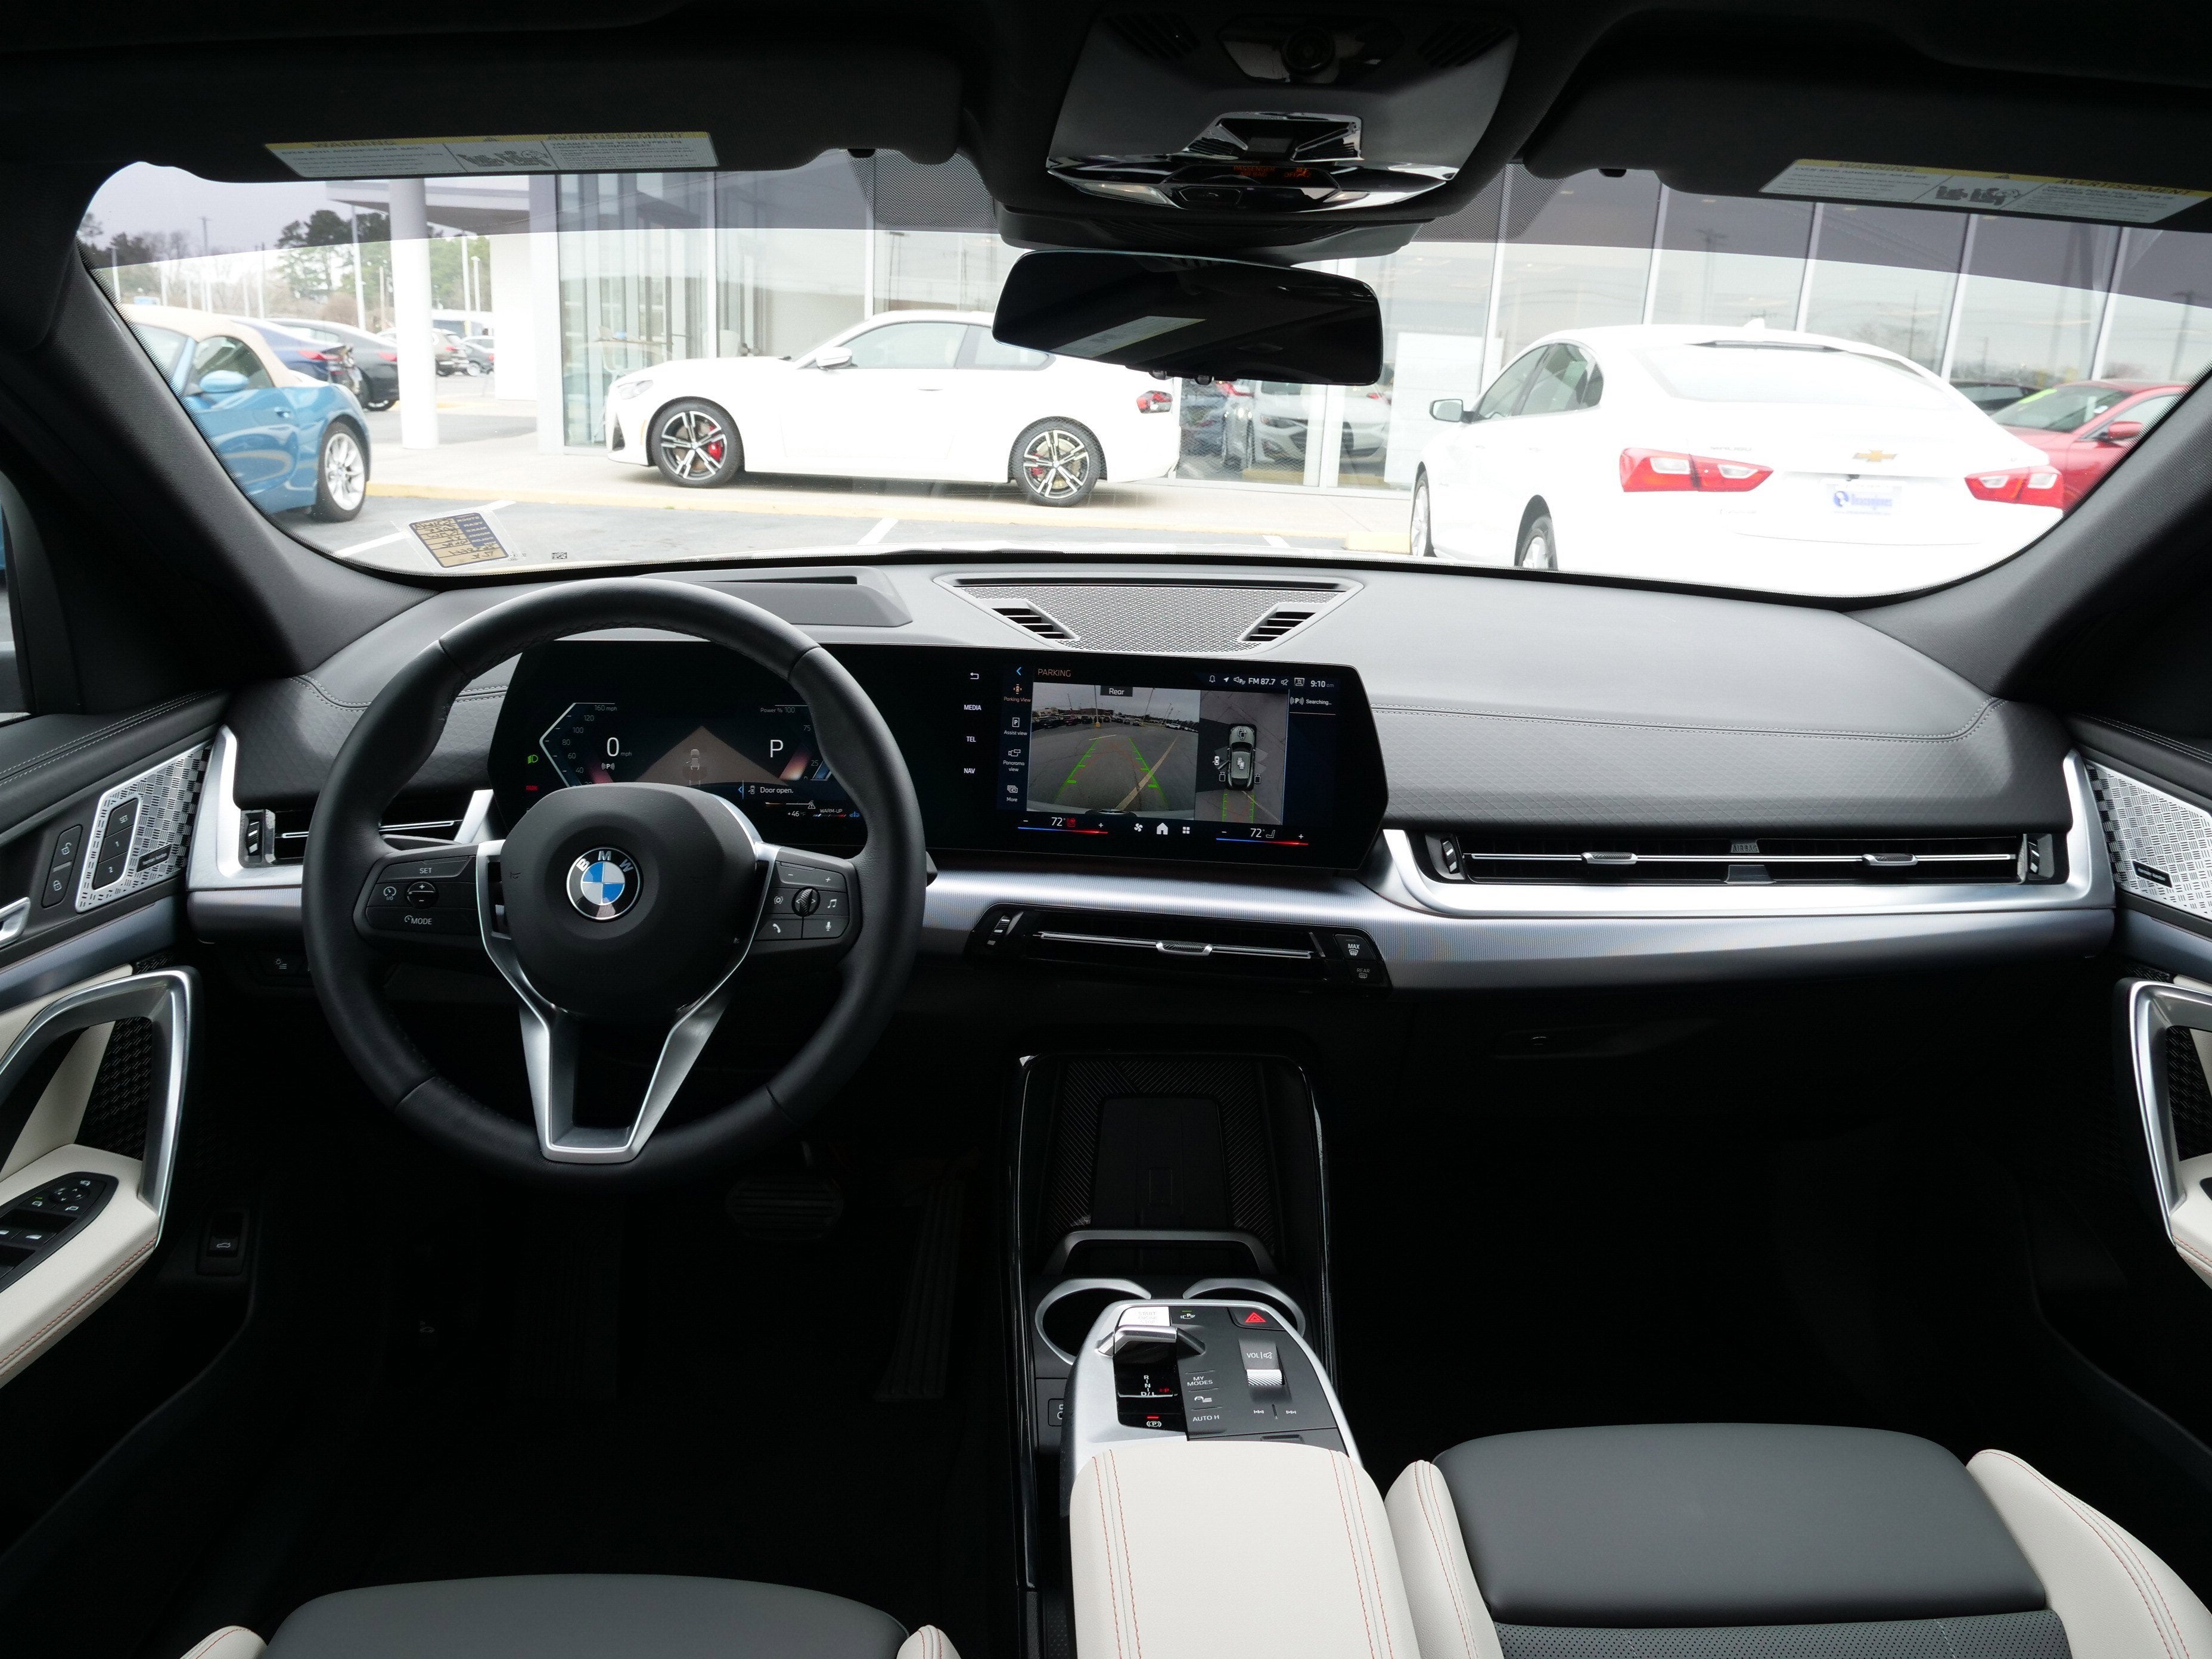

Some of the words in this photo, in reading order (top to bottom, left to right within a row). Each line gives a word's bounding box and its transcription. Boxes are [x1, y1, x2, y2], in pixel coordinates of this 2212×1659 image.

[1037, 669, 1071, 677] PARKING
[607, 737, 620, 757] 0
[770, 740, 784, 757] P
[576, 850, 633, 872] BMW
